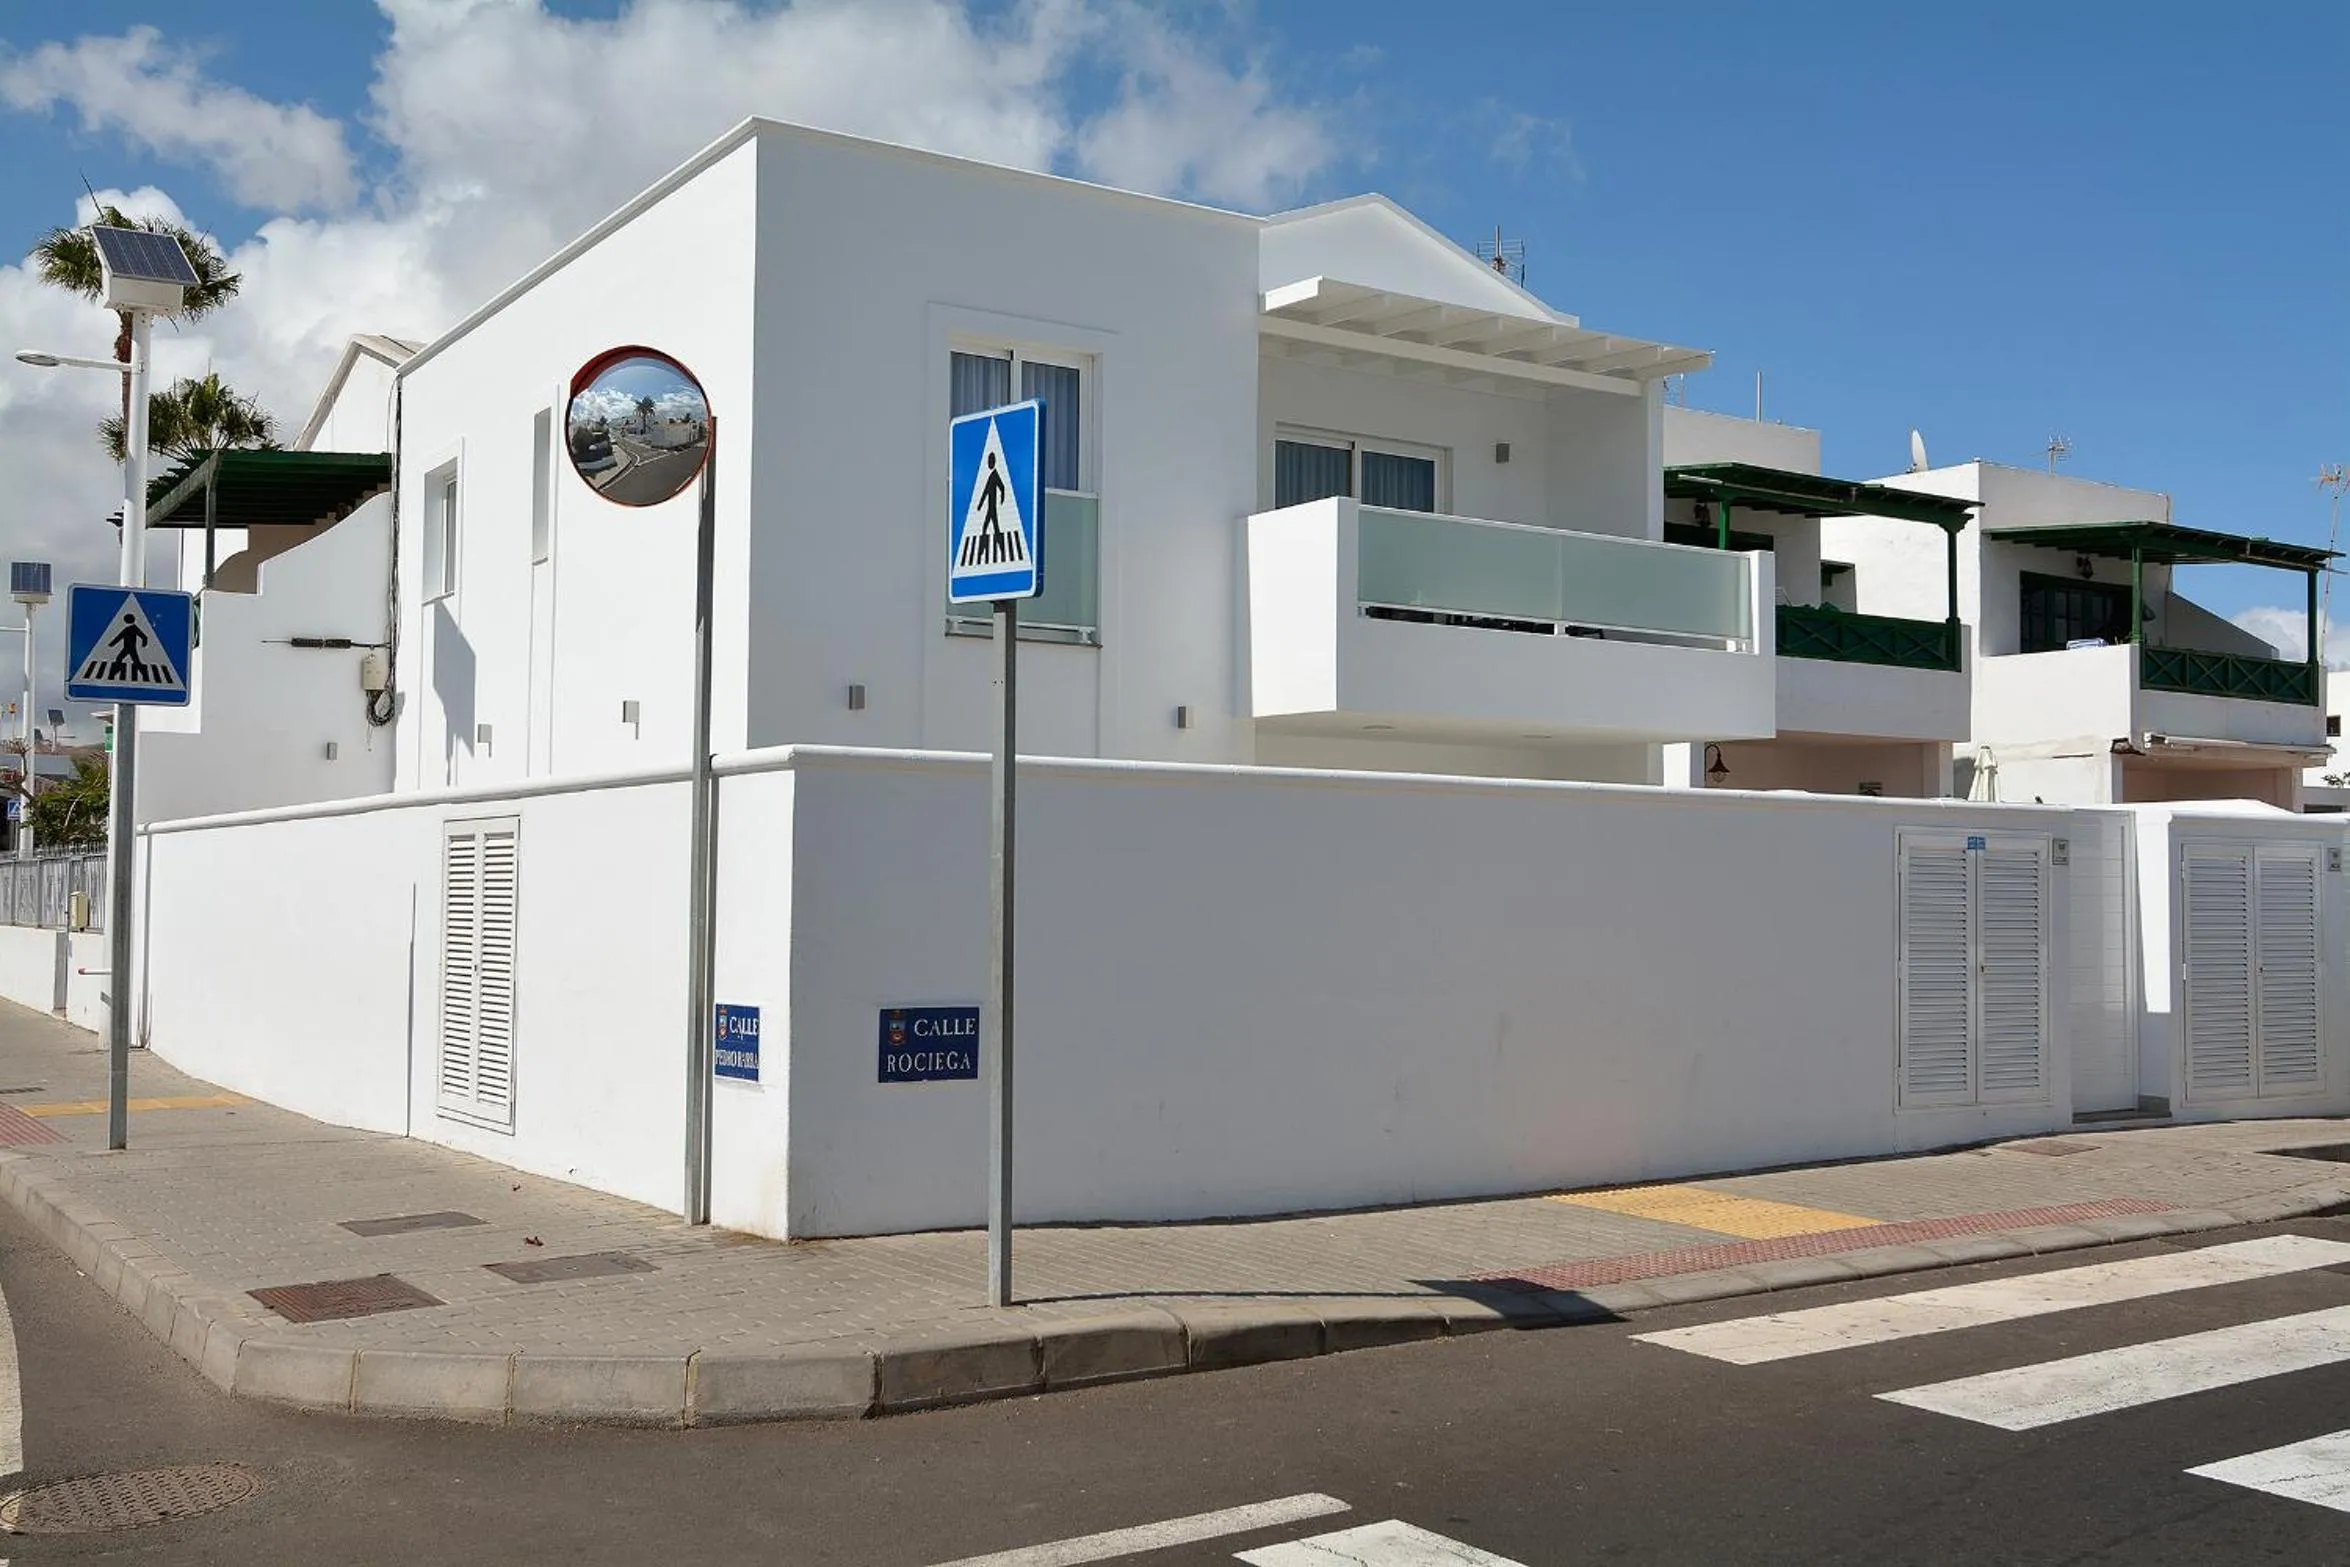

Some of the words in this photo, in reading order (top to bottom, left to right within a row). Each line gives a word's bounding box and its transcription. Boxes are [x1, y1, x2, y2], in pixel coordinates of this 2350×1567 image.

[729, 1016, 758, 1036] CALLE
[914, 1018, 975, 1036] CALLE
[887, 1051, 971, 1073] ROCIEGA
